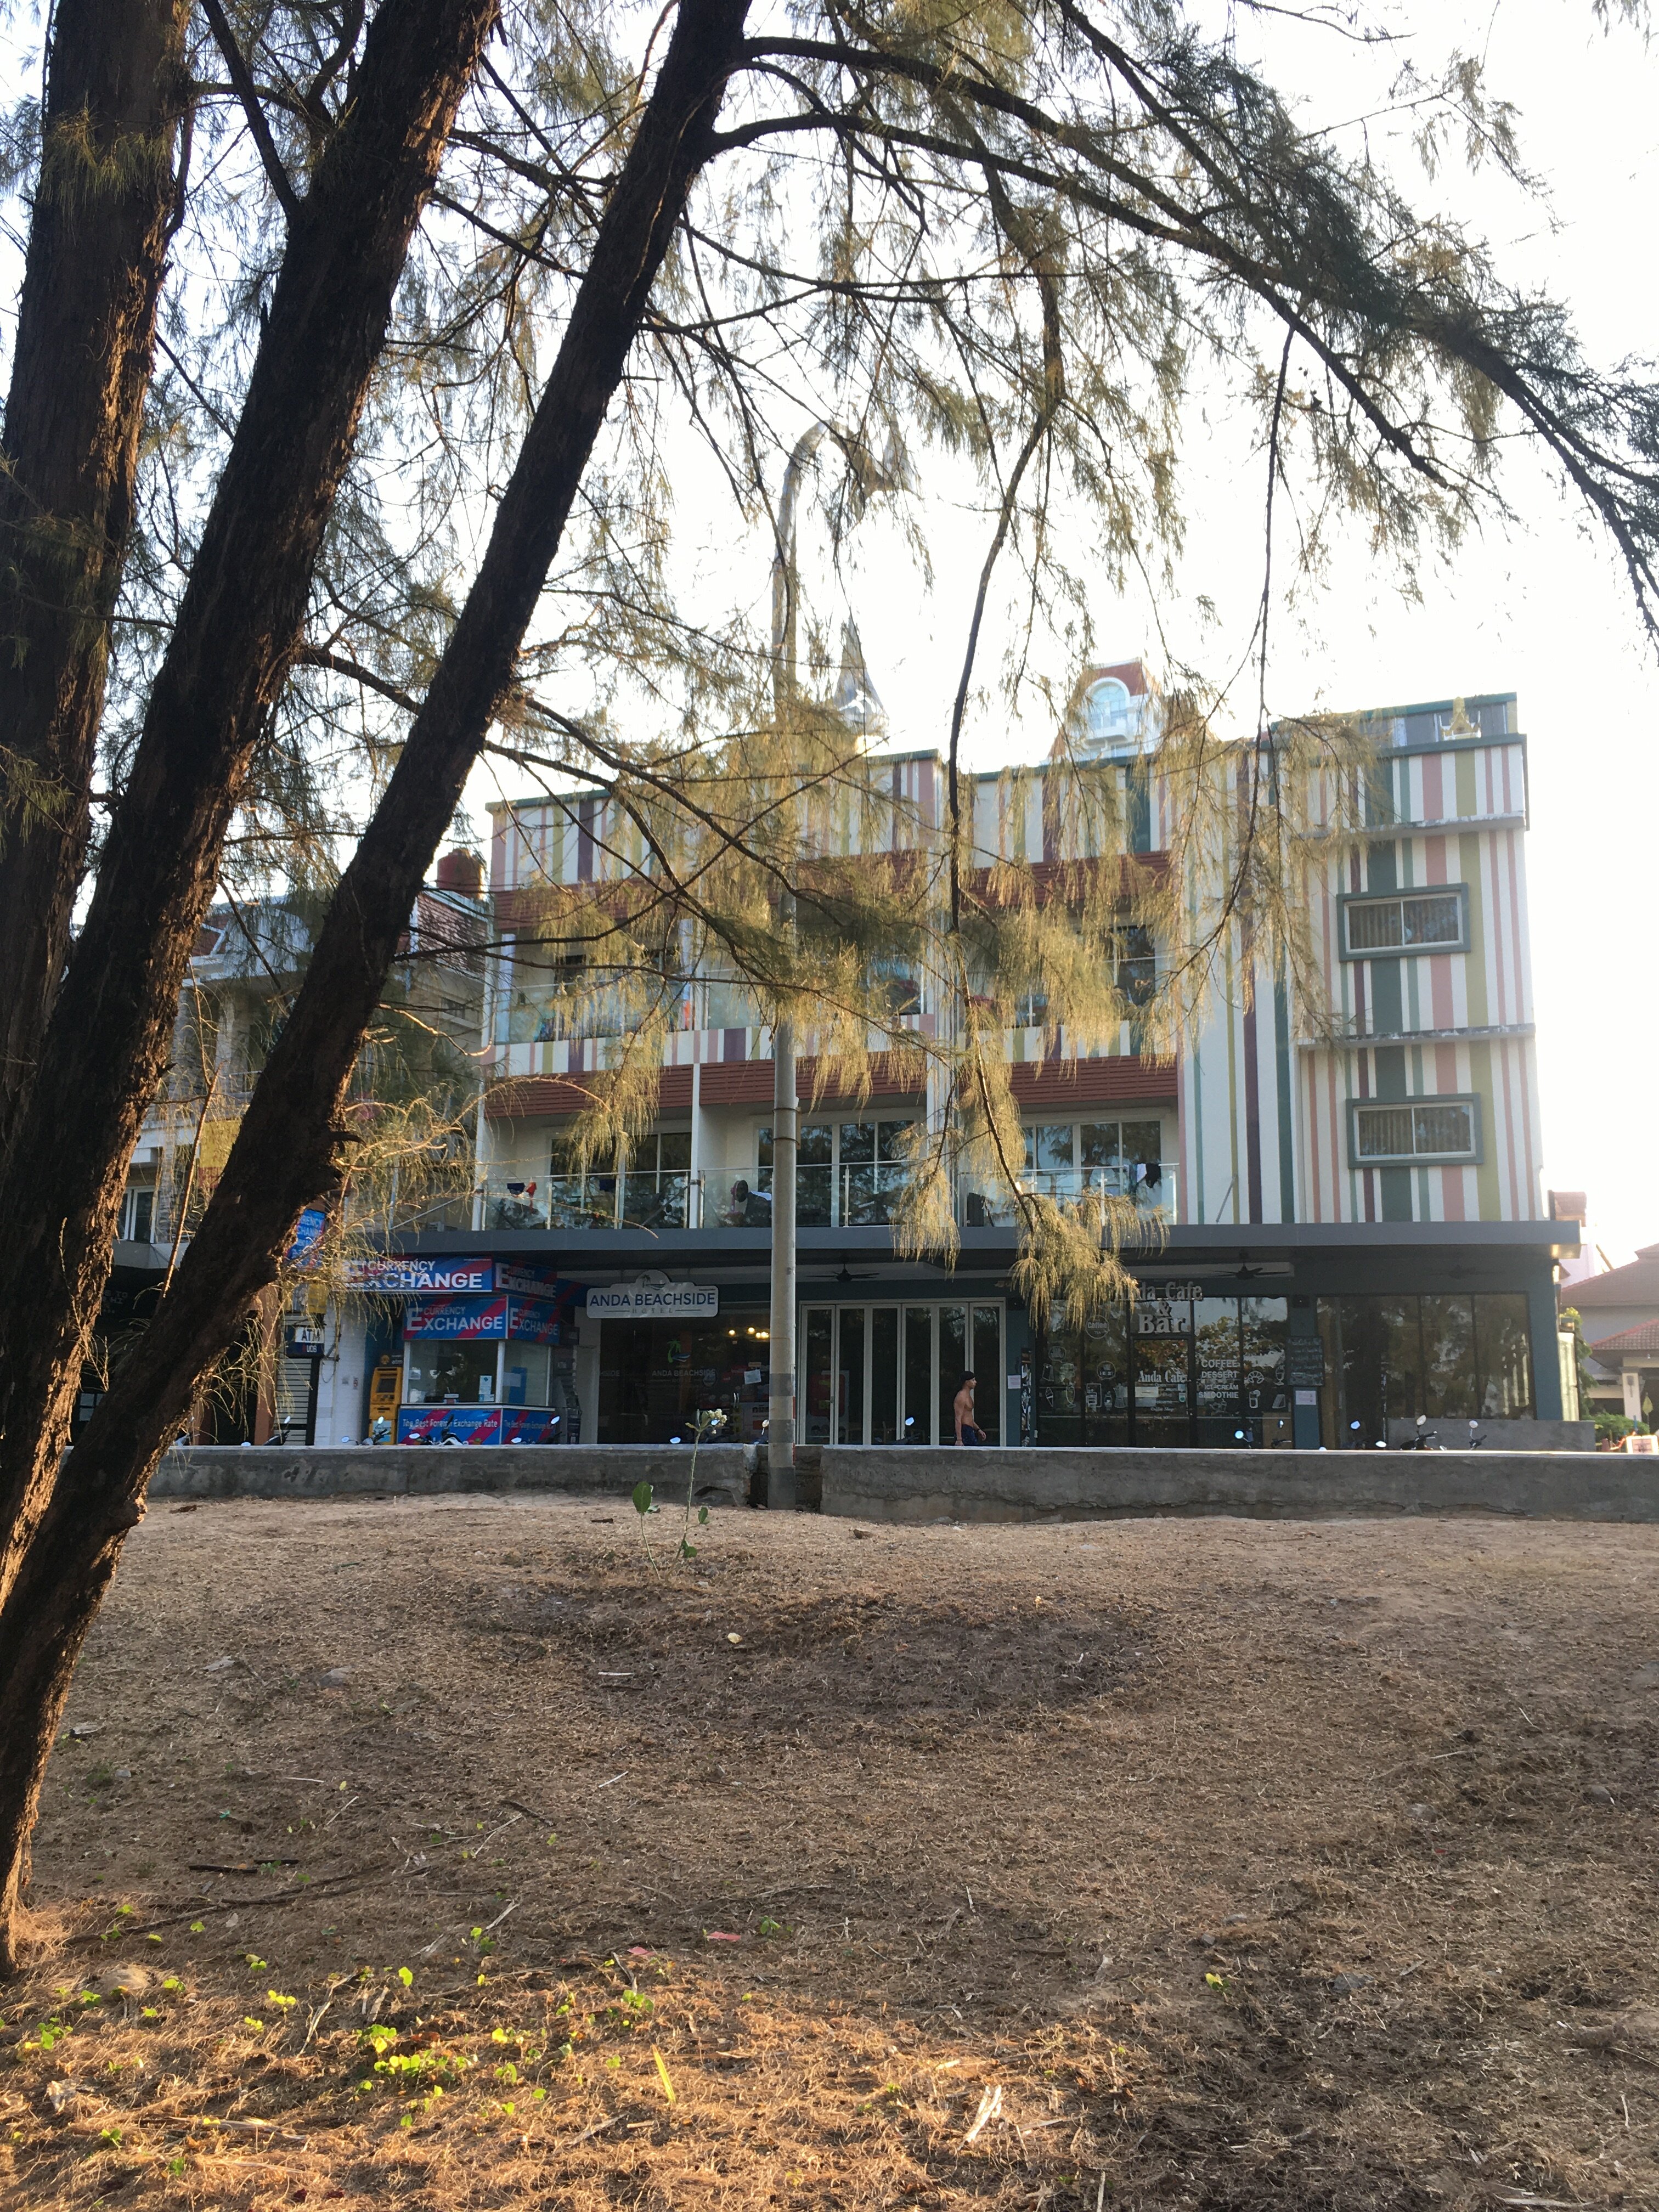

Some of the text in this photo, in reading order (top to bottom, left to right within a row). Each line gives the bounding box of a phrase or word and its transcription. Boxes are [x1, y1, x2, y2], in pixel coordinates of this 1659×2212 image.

[1165, 1281, 1203, 1301] Cafe
[589, 1292, 716, 1306] ANDA BEACHSIDE
[424, 1306, 466, 1315] CURRENCY
[407, 1307, 503, 1331] EXCHANGE
[510, 1307, 558, 1335] EXCHANGE
[1138, 1313, 1186, 1334] Bar
[1201, 1359, 1238, 1368] COFFEE
[1138, 1370, 1162, 1383] Anda
[415, 1419, 428, 1427] Best
[454, 1419, 482, 1429] Exchange
[484, 1419, 498, 1427] Rate
